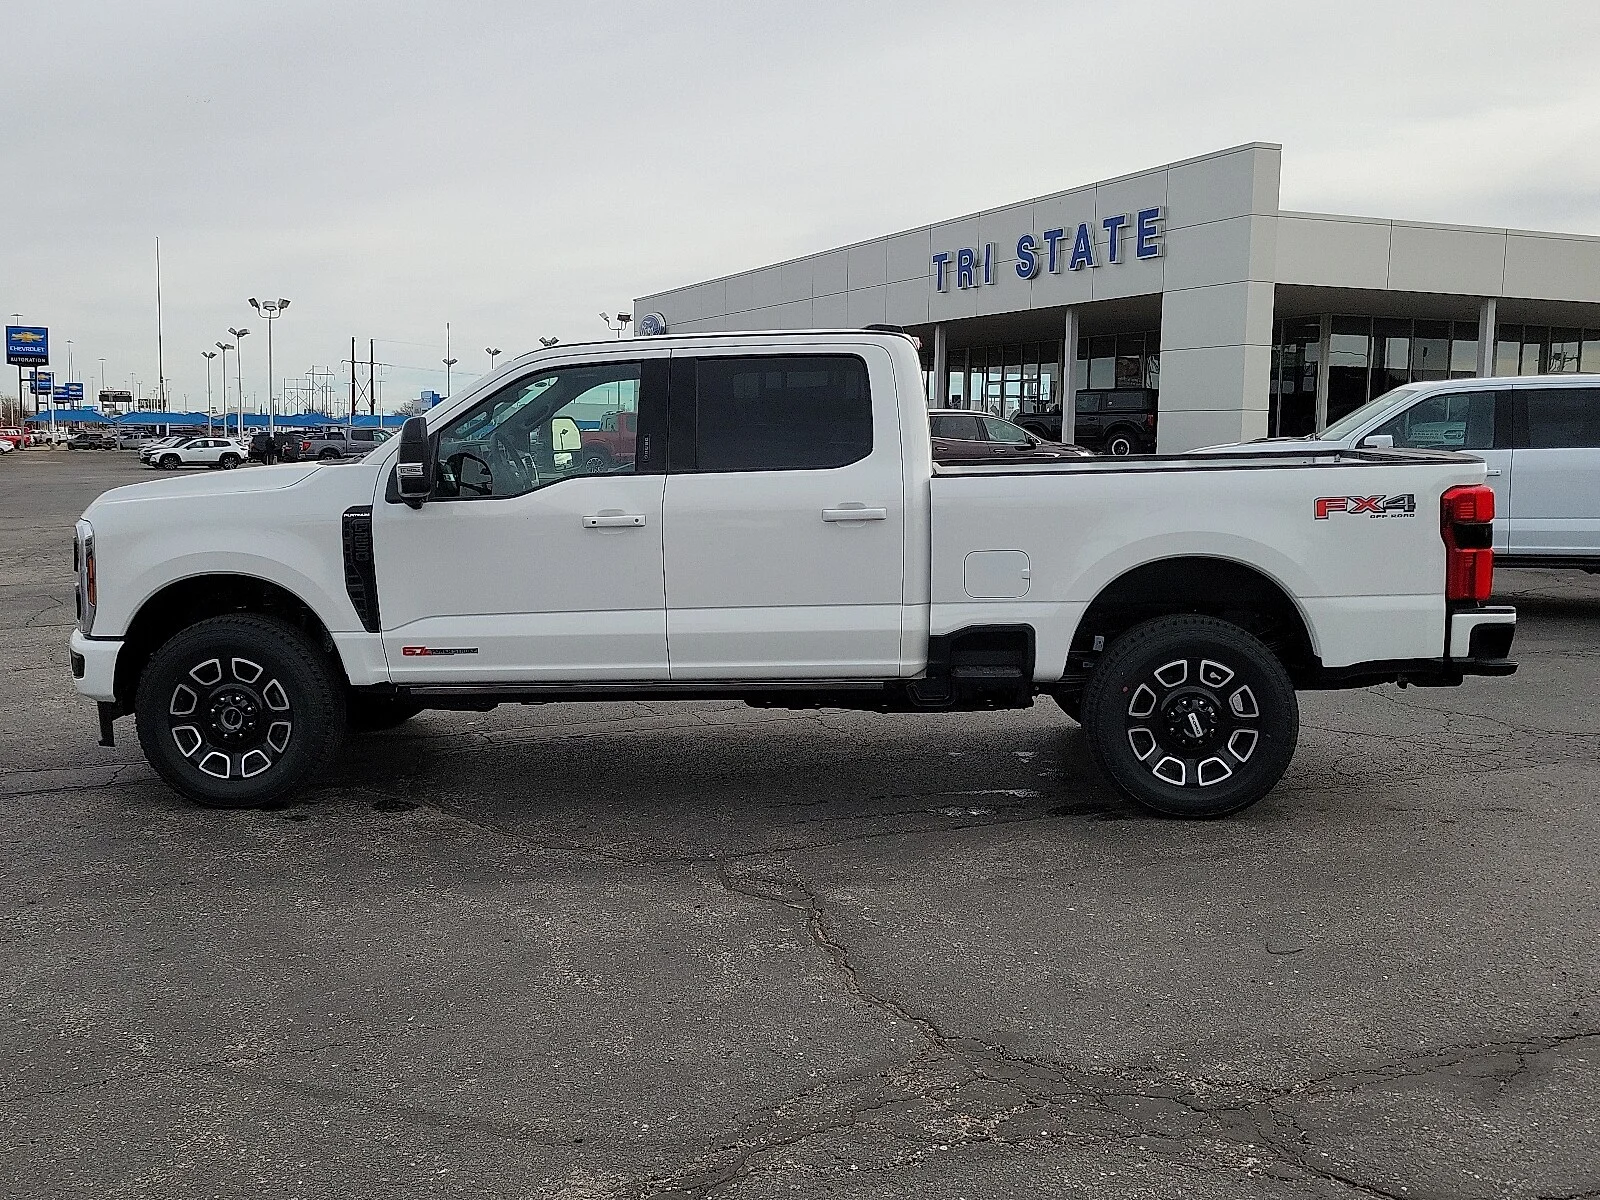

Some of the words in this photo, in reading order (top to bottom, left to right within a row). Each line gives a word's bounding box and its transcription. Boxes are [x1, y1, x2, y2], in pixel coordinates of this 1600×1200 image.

[932, 241, 995, 293] TRI
[1015, 206, 1164, 280] STATE
[1314, 493, 1416, 520] FX4
